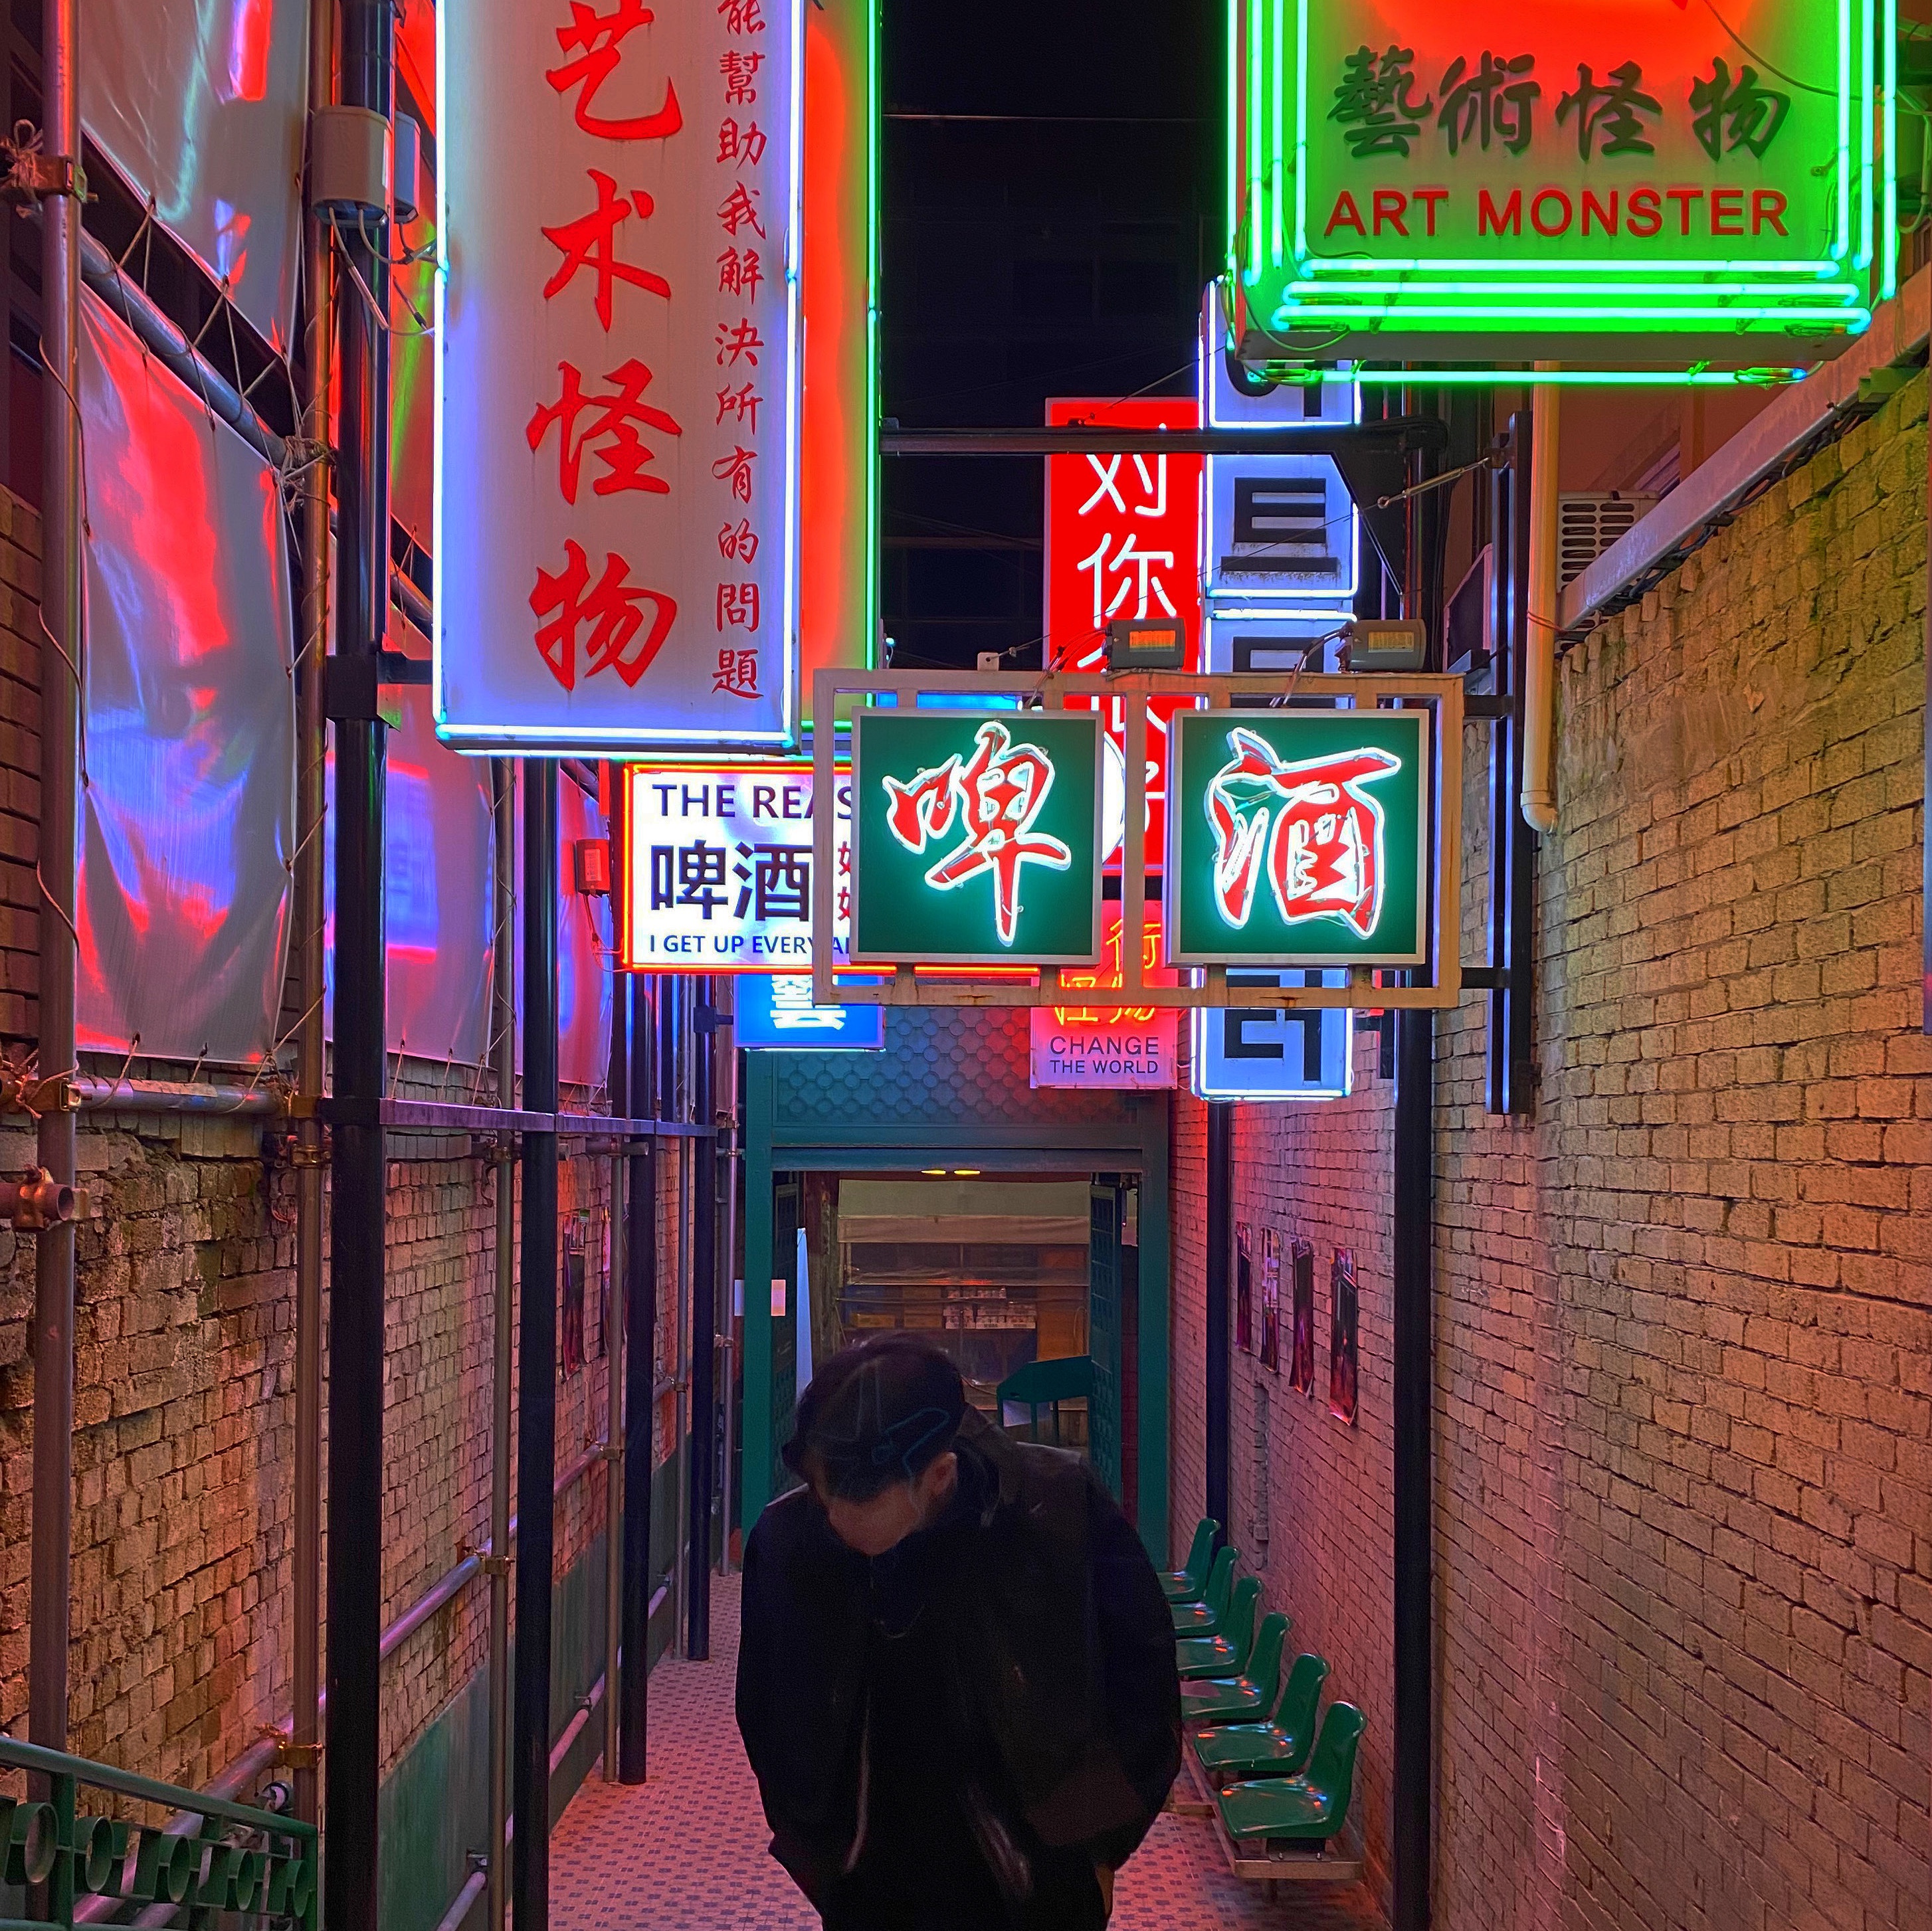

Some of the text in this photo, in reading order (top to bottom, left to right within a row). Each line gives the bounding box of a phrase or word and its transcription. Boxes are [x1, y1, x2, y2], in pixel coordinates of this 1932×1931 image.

[1328, 45, 1792, 161] 藝術怪物
[1325, 189, 1788, 237] ART MONSTER
[652, 784, 735, 818] THE
[650, 839, 811, 921] 啤酒
[650, 935, 655, 952] I
[664, 935, 705, 953] GET
[714, 935, 743, 953] UP
[1050, 1036, 1159, 1055] CHANGE
[1050, 1060, 1158, 1073] THE WORLD
